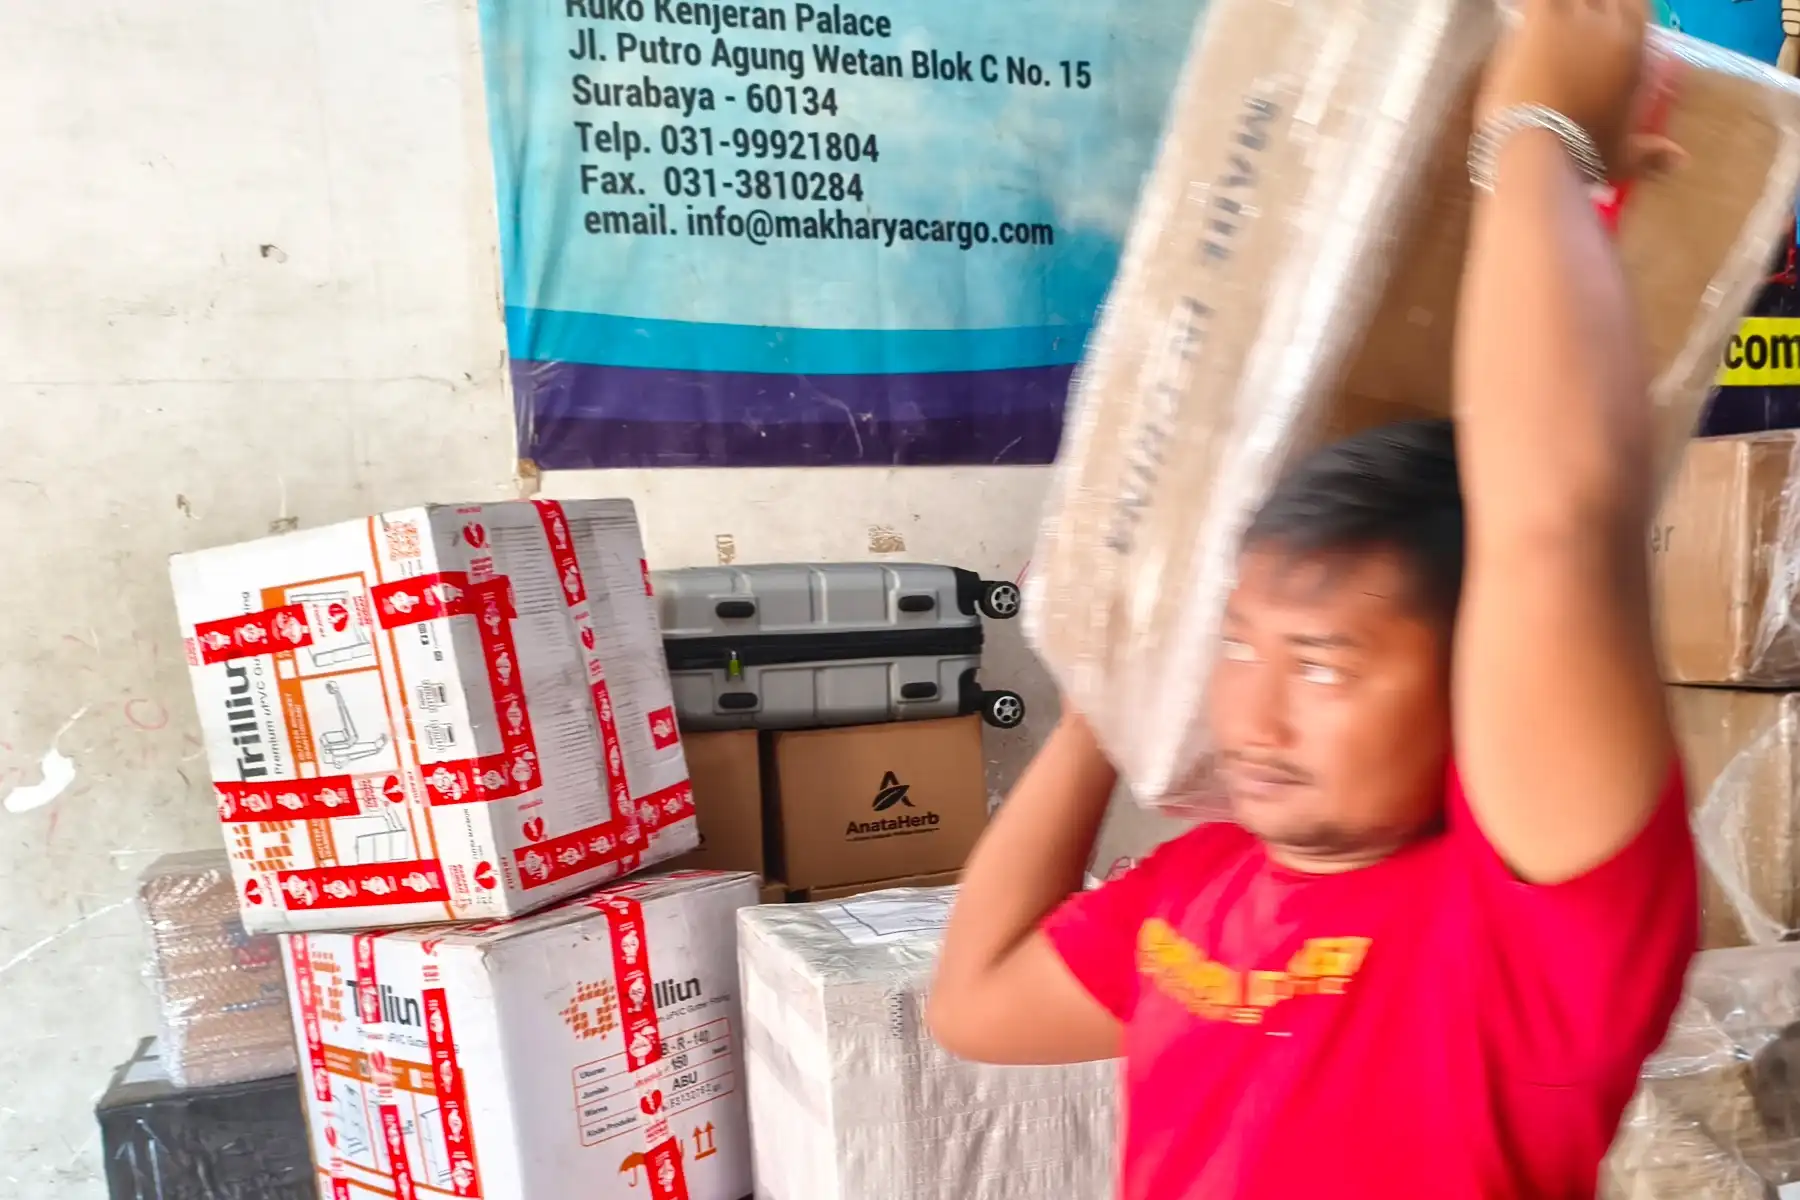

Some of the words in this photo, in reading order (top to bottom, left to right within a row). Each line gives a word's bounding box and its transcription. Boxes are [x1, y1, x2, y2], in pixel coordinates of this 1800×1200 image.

[567, 0, 643, 21] Ruko
[655, 0, 785, 35] Kenjeran
[796, 4, 890, 38] Palace
[570, 28, 605, 61] Jl.
[618, 33, 700, 66] Putro
[712, 39, 803, 80] Agung
[813, 44, 902, 78] Wetan
[912, 50, 973, 82] Blok
[981, 55, 998, 83] C
[1007, 56, 1049, 87] No.
[1060, 61, 1091, 89] 15
[573, 75, 714, 117] Surabaya
[746, 85, 838, 116] 60134
[574, 120, 650, 162] Telp.
[661, 125, 879, 163] 031-99921804
[581, 165, 644, 195] Fax.
[665, 167, 863, 202] 031-3810284
[585, 204, 676, 235] email.
[687, 205, 1055, 250] info@makharyacargo.com
[846, 811, 940, 835] AnataHerb
